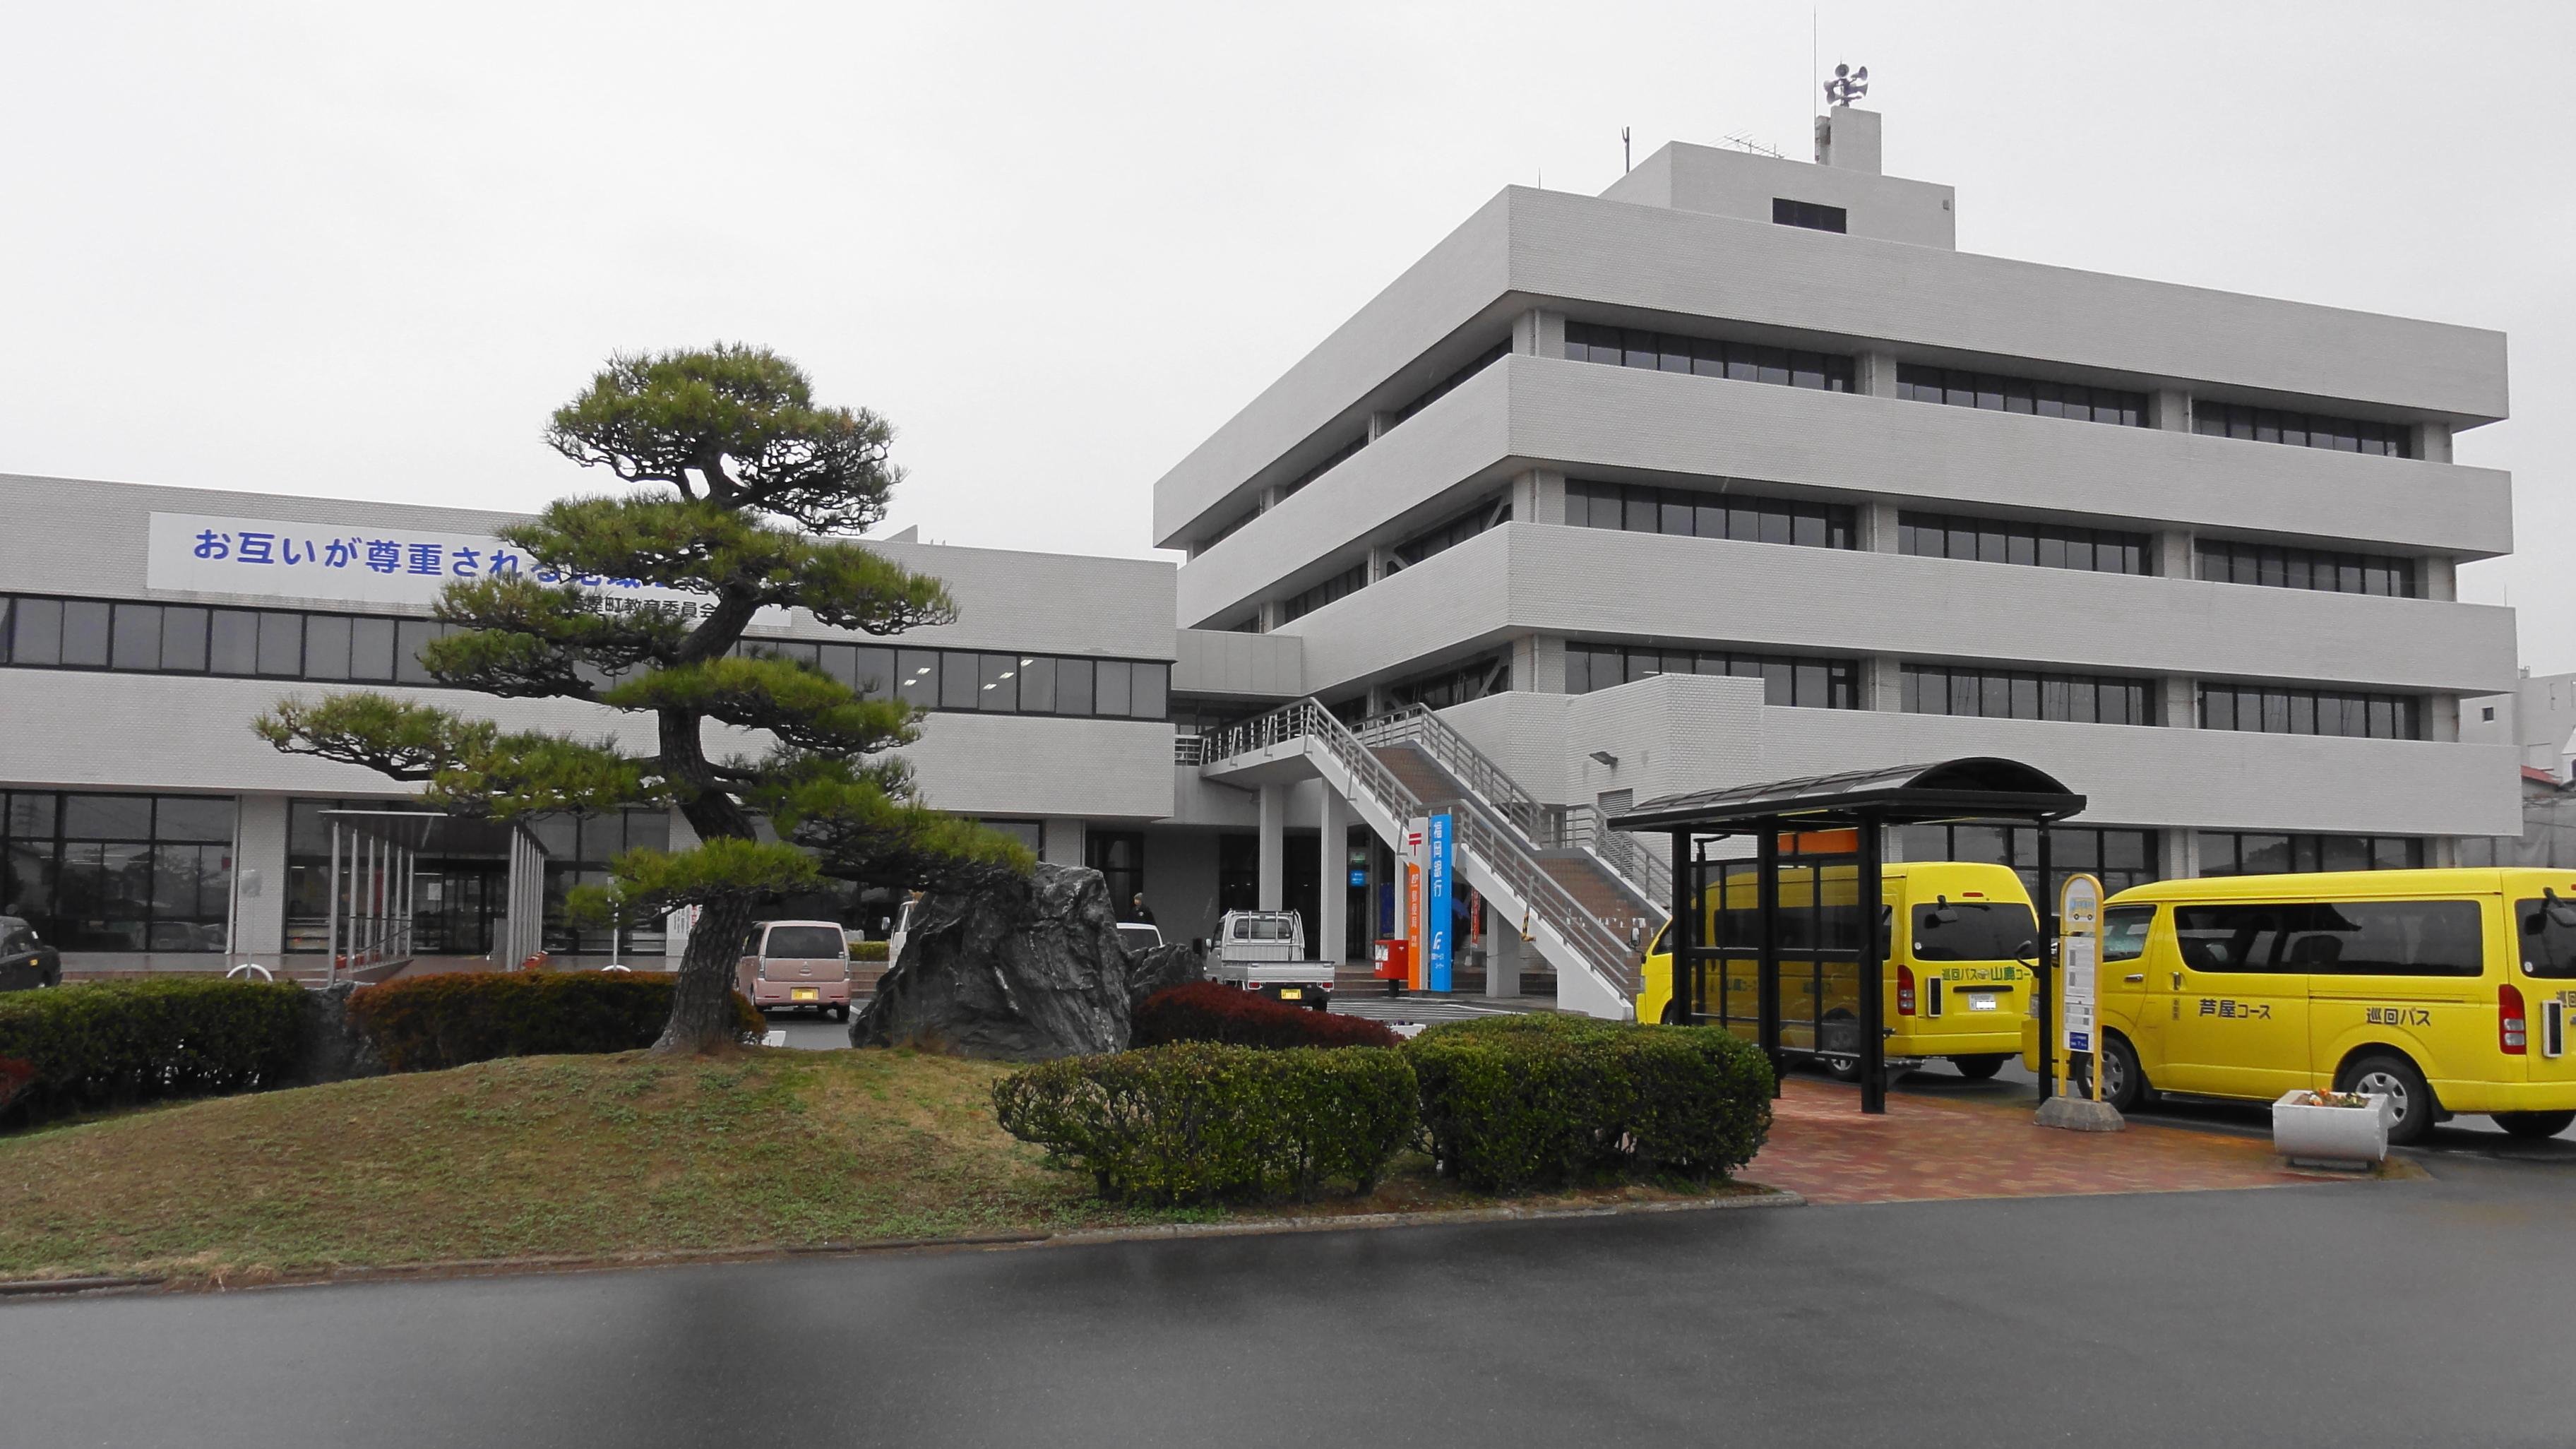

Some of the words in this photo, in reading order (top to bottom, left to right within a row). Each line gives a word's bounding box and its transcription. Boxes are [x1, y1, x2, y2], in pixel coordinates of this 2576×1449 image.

[1433, 821, 1442, 897] 福岡銀行
[1942, 968, 1976, 980] 巡回バス
[2199, 998, 2271, 1020] 芦屋コース
[2366, 1008, 2431, 1026] 巡回バス
